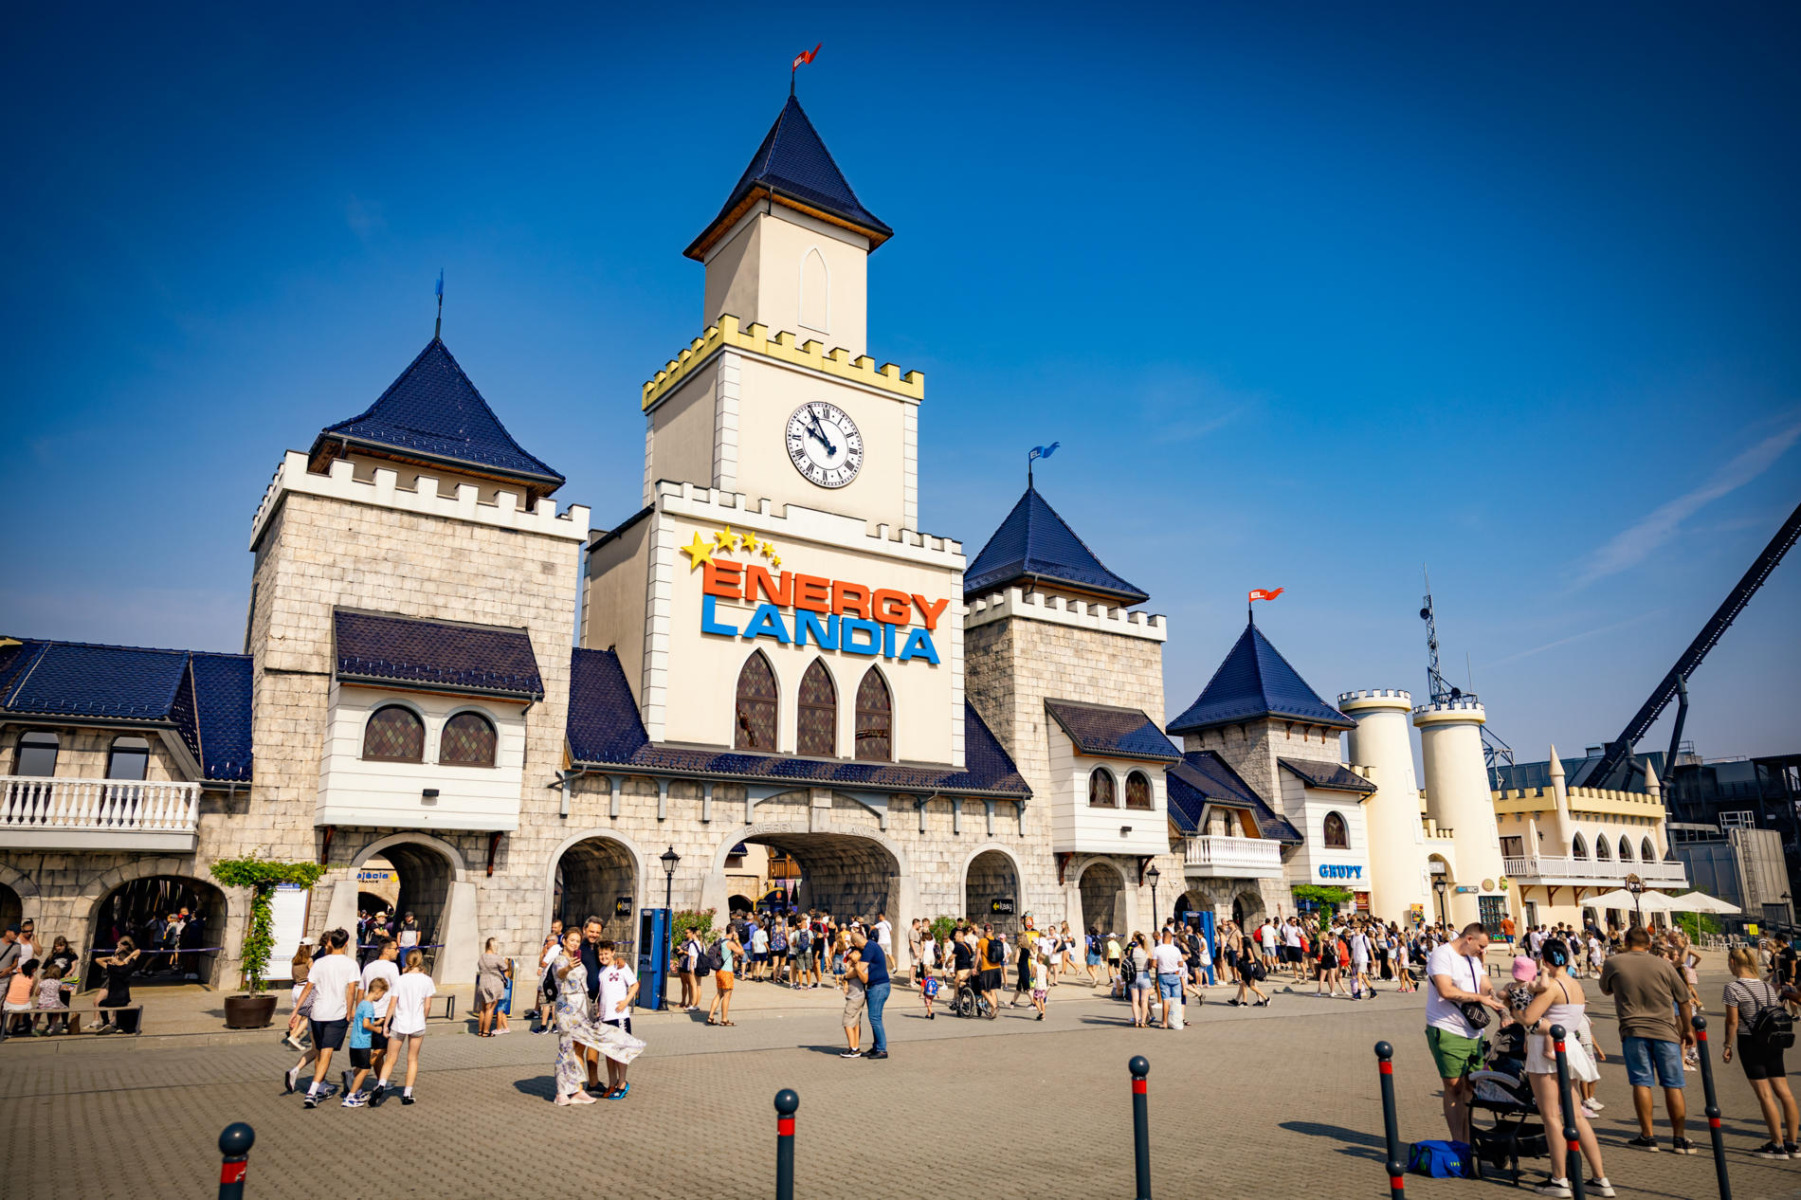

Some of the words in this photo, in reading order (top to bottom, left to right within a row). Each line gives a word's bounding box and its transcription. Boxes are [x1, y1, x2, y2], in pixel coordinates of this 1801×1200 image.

[701, 594, 941, 665] LANDIA
[702, 558, 950, 630] ENERGY
[1319, 864, 1362, 879] GRUPY
